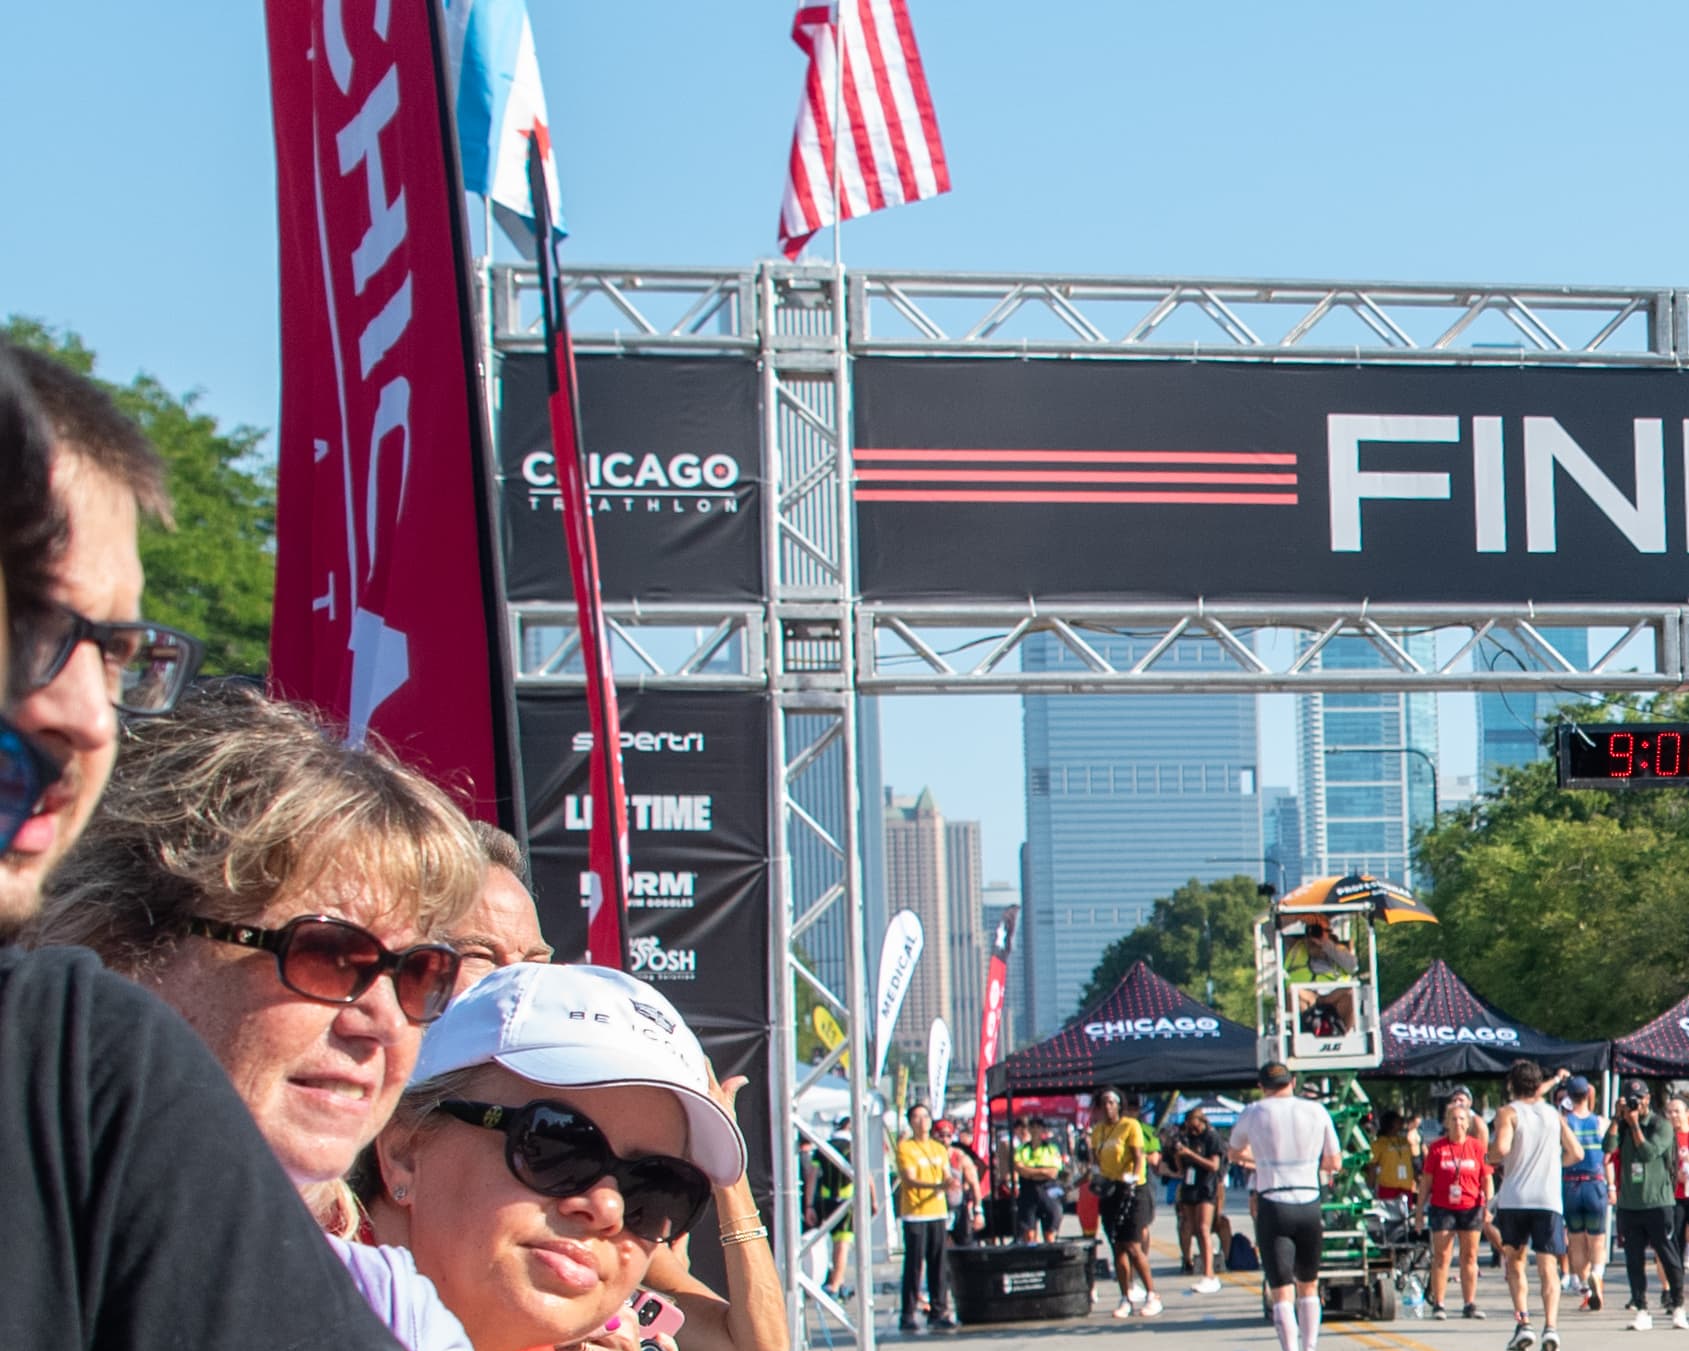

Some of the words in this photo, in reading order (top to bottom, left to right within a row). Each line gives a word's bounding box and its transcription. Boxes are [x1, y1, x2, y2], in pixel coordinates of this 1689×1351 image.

[521, 450, 740, 488] CICAGO
[528, 497, 739, 513] TRATHLON
[572, 731, 704, 752] spertri
[631, 795, 712, 831] TIME
[881, 935, 917, 1019] MEDICAL
[569, 1010, 610, 1024] BE
[1085, 1017, 1219, 1036] CHICAGO
[1390, 1023, 1518, 1042] CHICAGO
